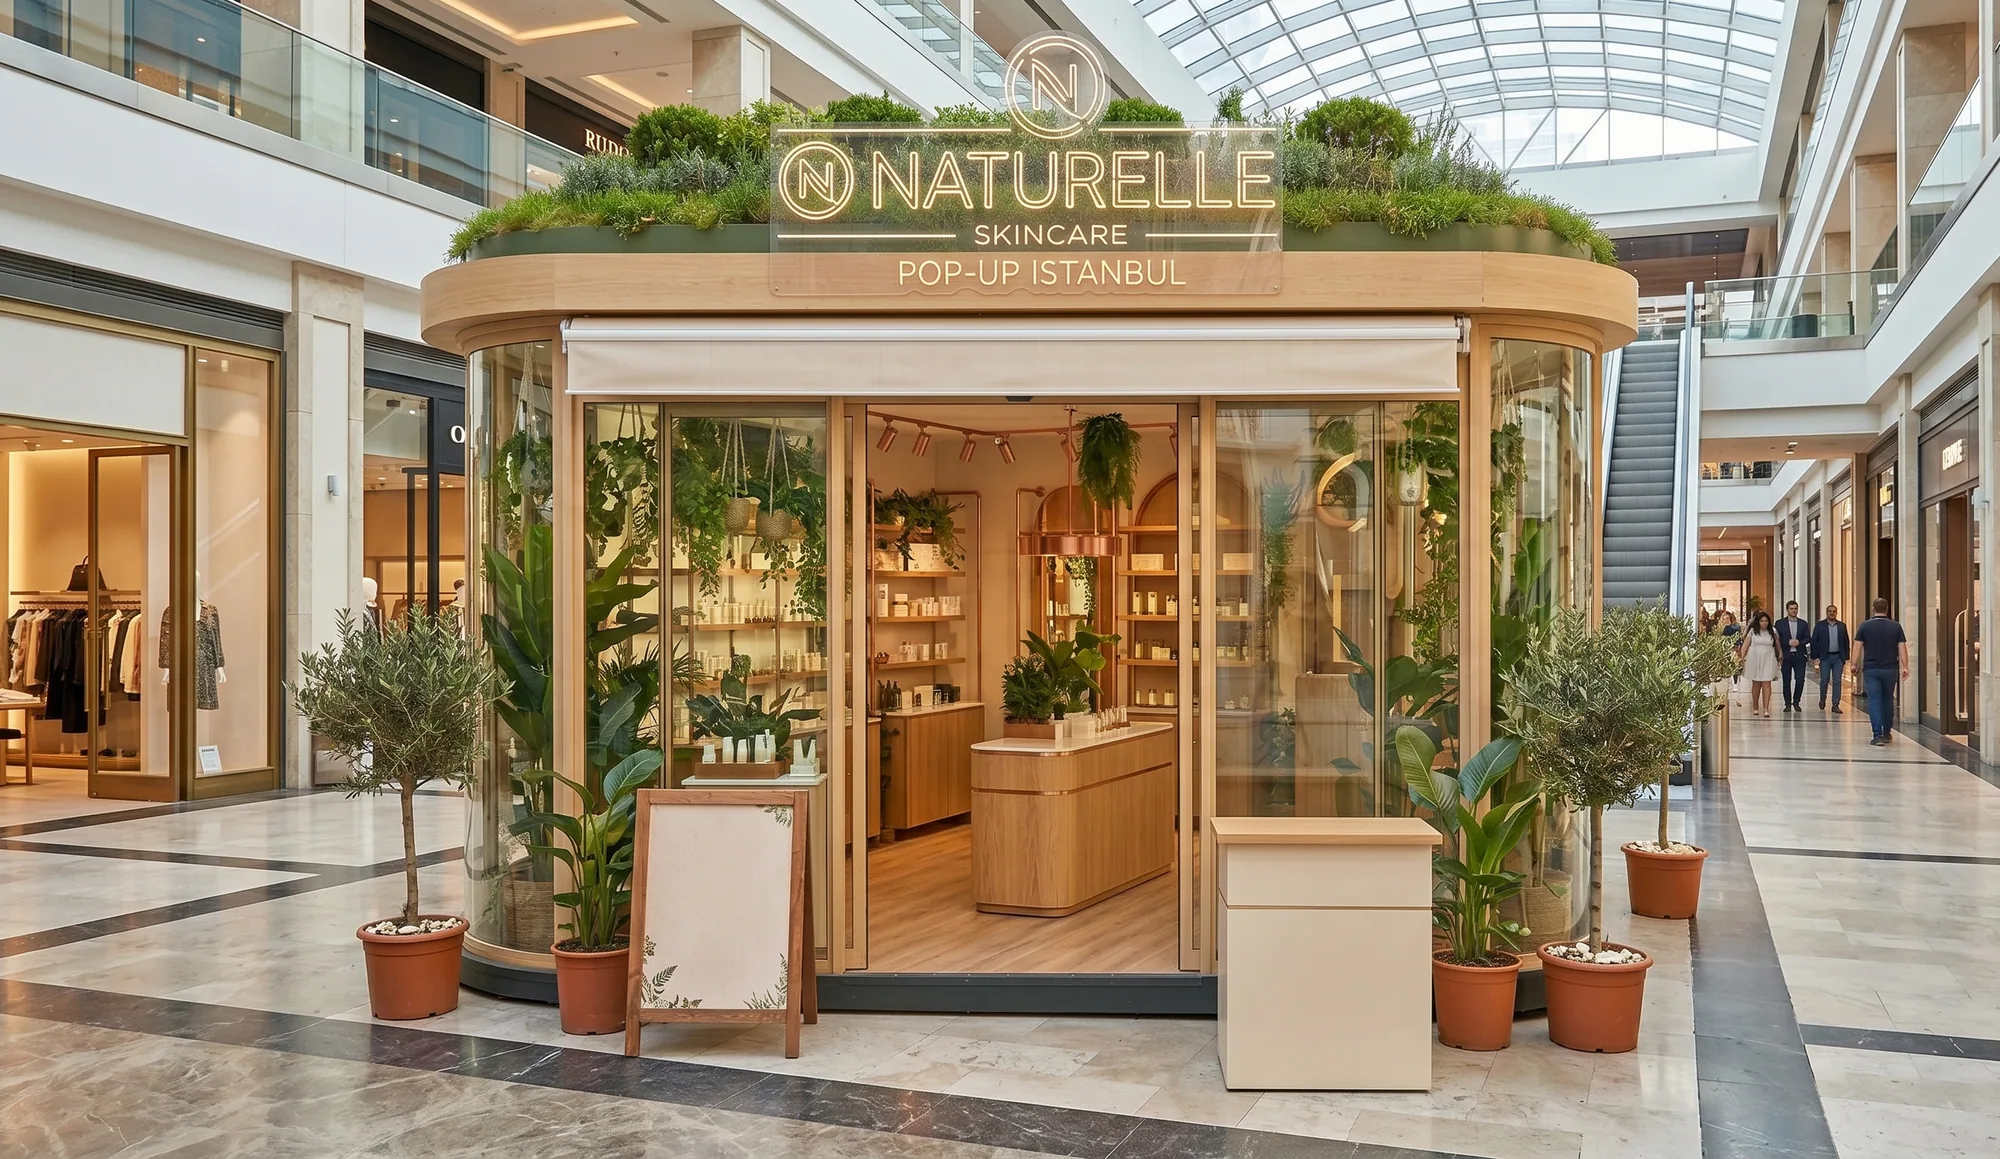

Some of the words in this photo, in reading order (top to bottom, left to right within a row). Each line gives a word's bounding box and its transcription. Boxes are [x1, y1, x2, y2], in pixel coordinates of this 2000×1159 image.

[872, 150, 1276, 210] NATURELLE
[974, 224, 1129, 246] SKINCARE
[898, 260, 1020, 287] POP-UP
[1032, 259, 1187, 287] ISTANBUL
